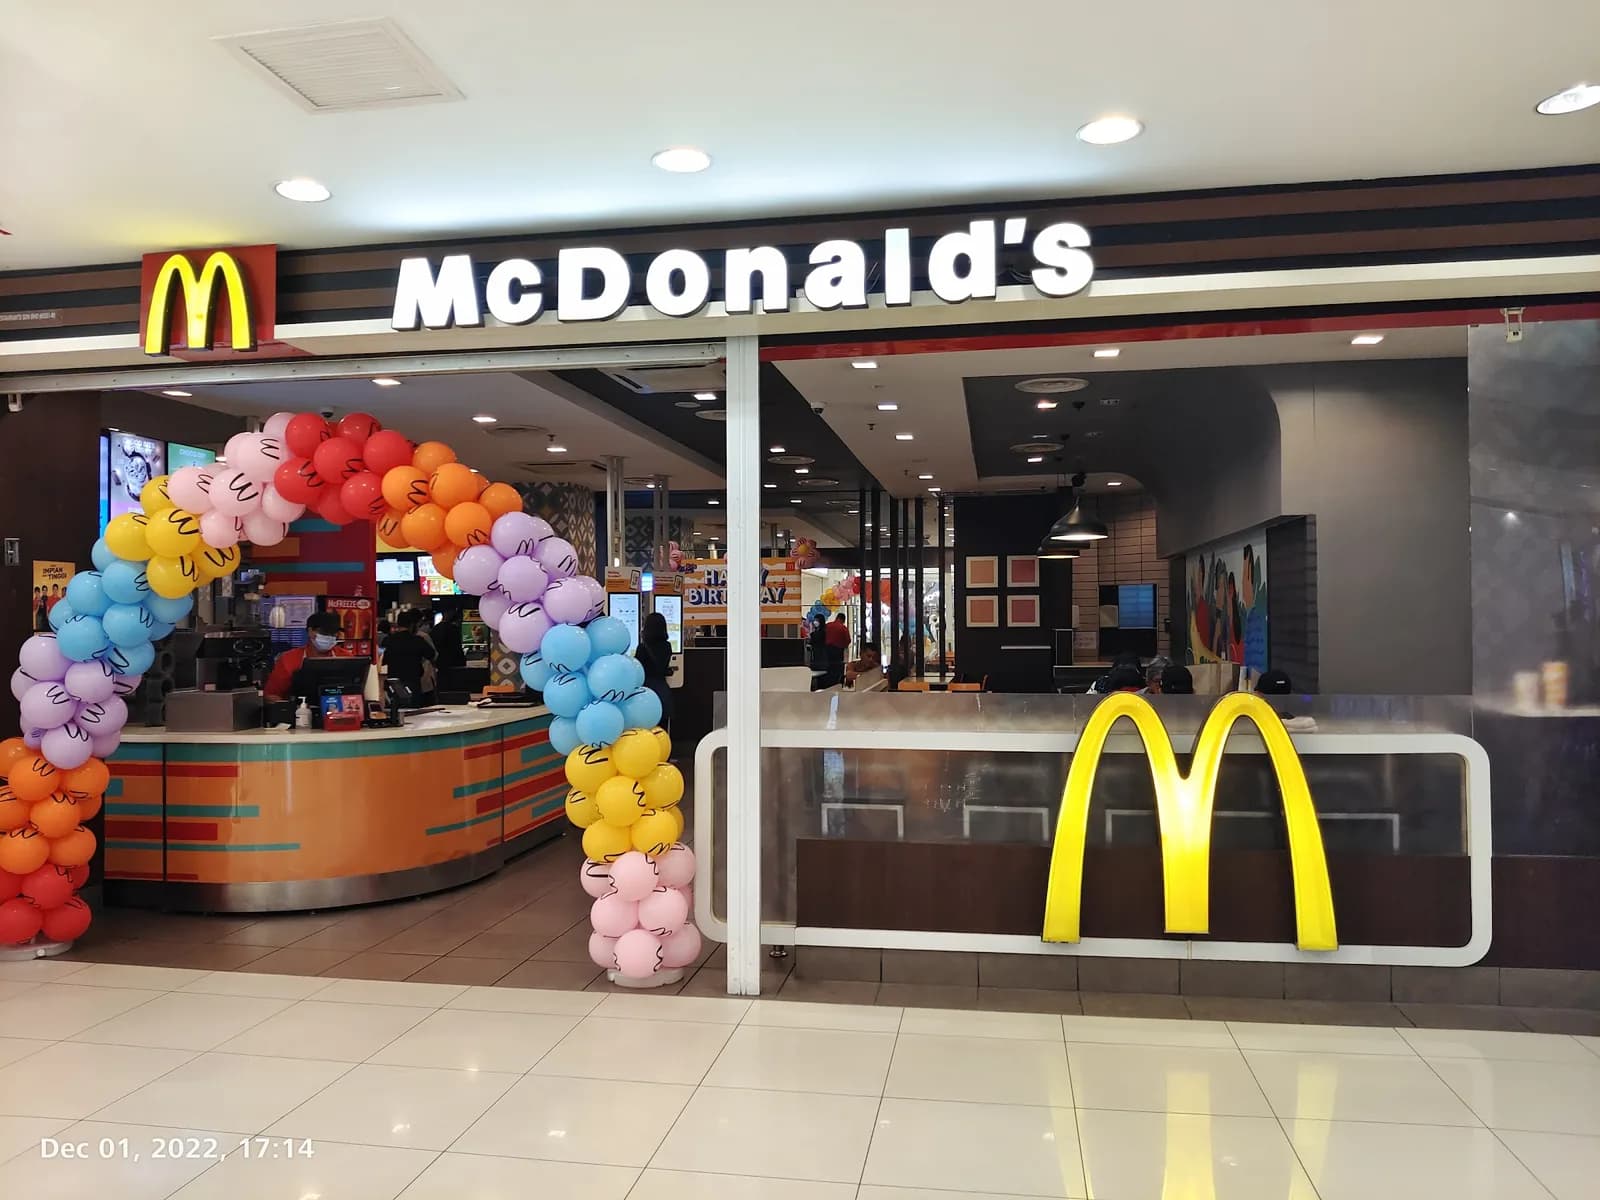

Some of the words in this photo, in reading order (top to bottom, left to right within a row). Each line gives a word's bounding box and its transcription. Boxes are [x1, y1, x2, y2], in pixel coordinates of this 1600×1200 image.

[391, 217, 1095, 331] McDonald's
[704, 568, 769, 587] HAY
[688, 586, 787, 606] BIRTAY
